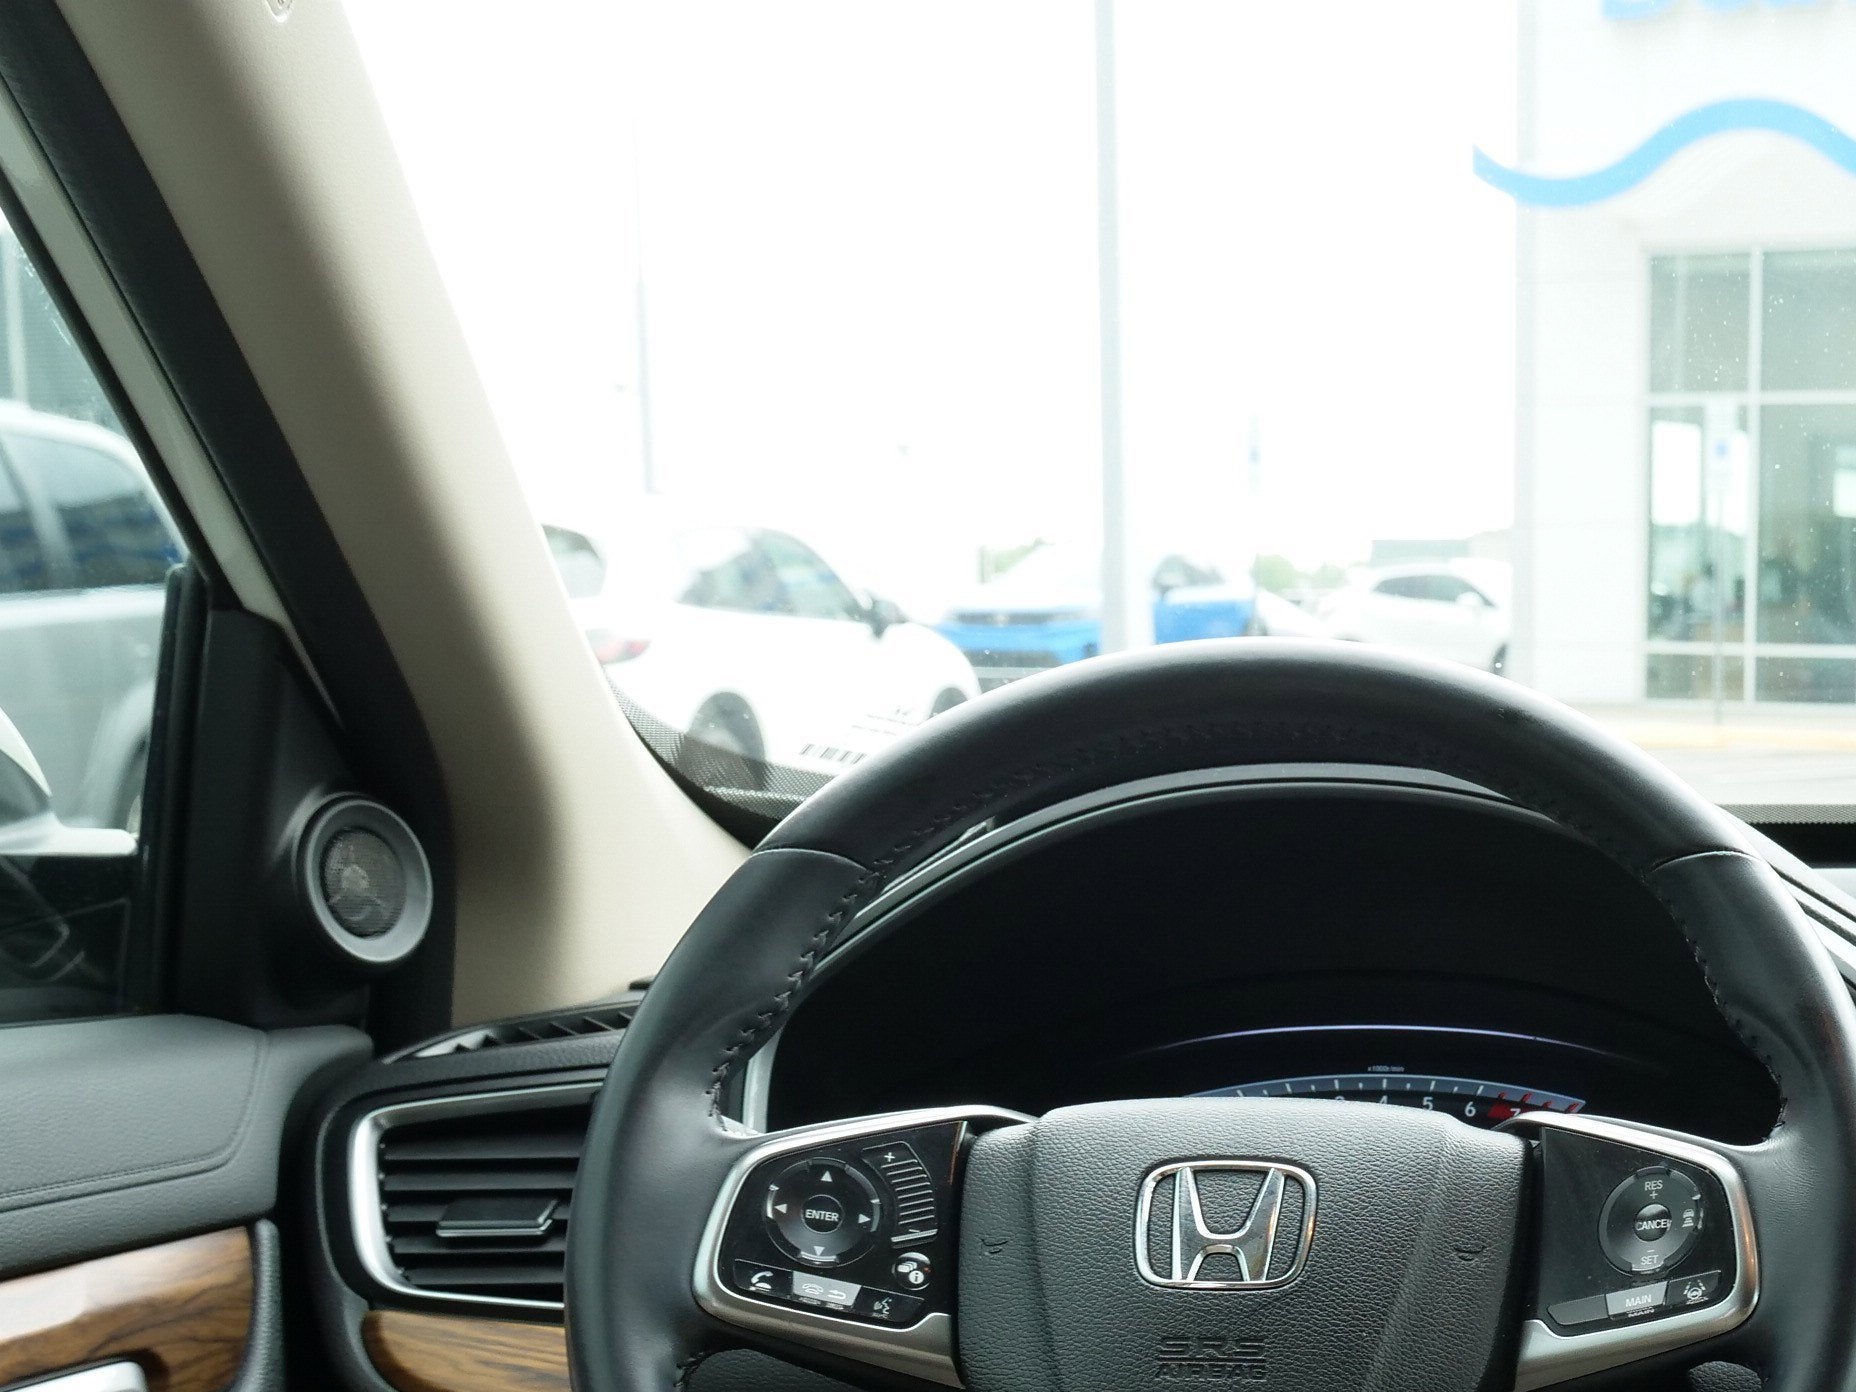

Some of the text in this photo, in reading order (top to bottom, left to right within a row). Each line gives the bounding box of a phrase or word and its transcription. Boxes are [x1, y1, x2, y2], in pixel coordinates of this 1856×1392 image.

[1422, 1096, 1434, 1110] 5
[1464, 1101, 1477, 1117] 6
[1644, 1180, 1664, 1191] RES
[805, 1208, 840, 1223] ENTER
[1640, 1254, 1660, 1266] SET
[1625, 1293, 1652, 1308] MAIN
[1157, 1336, 1268, 1360] SRS
[1154, 1361, 1268, 1383] AIRBAG
